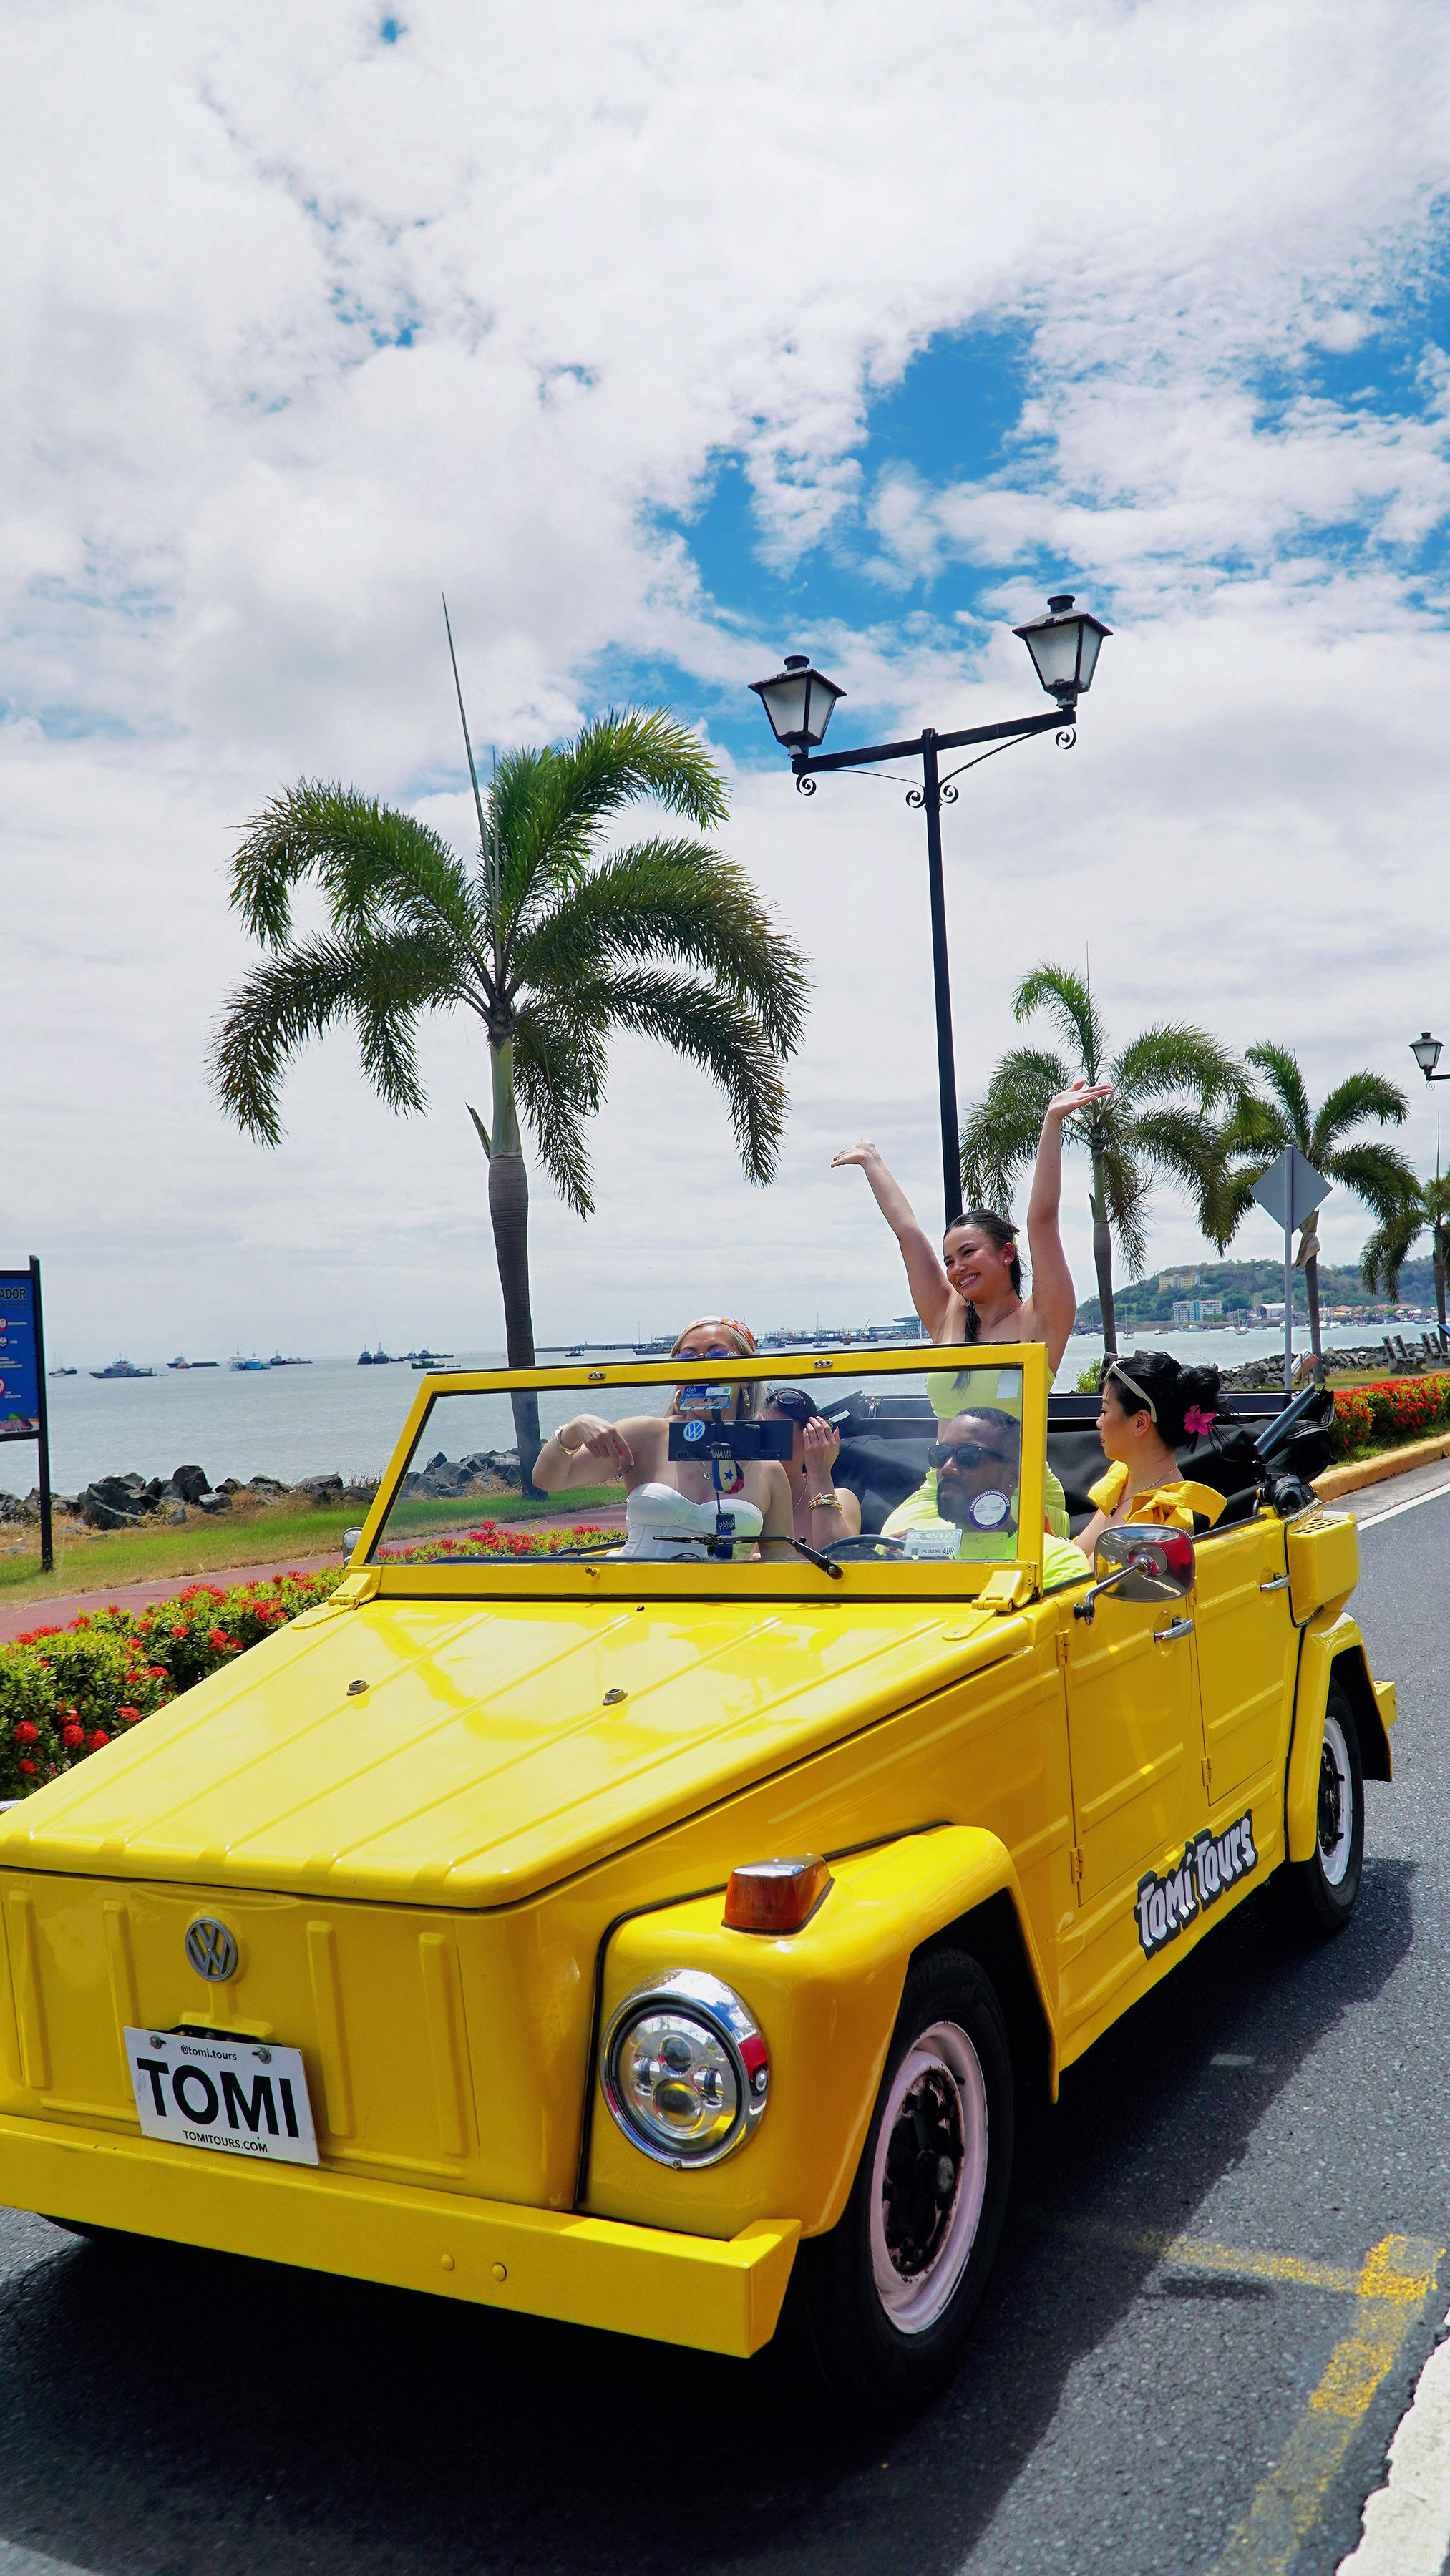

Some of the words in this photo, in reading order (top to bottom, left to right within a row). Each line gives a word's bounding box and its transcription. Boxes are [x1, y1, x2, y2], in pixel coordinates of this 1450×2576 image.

[970, 1491, 991, 1512] TRANSPORTE
[180, 2044, 238, 2061] @tomi.tours
[136, 2057, 300, 2139] TOMI
[183, 2129, 268, 2153] TOMITOURS.COM
